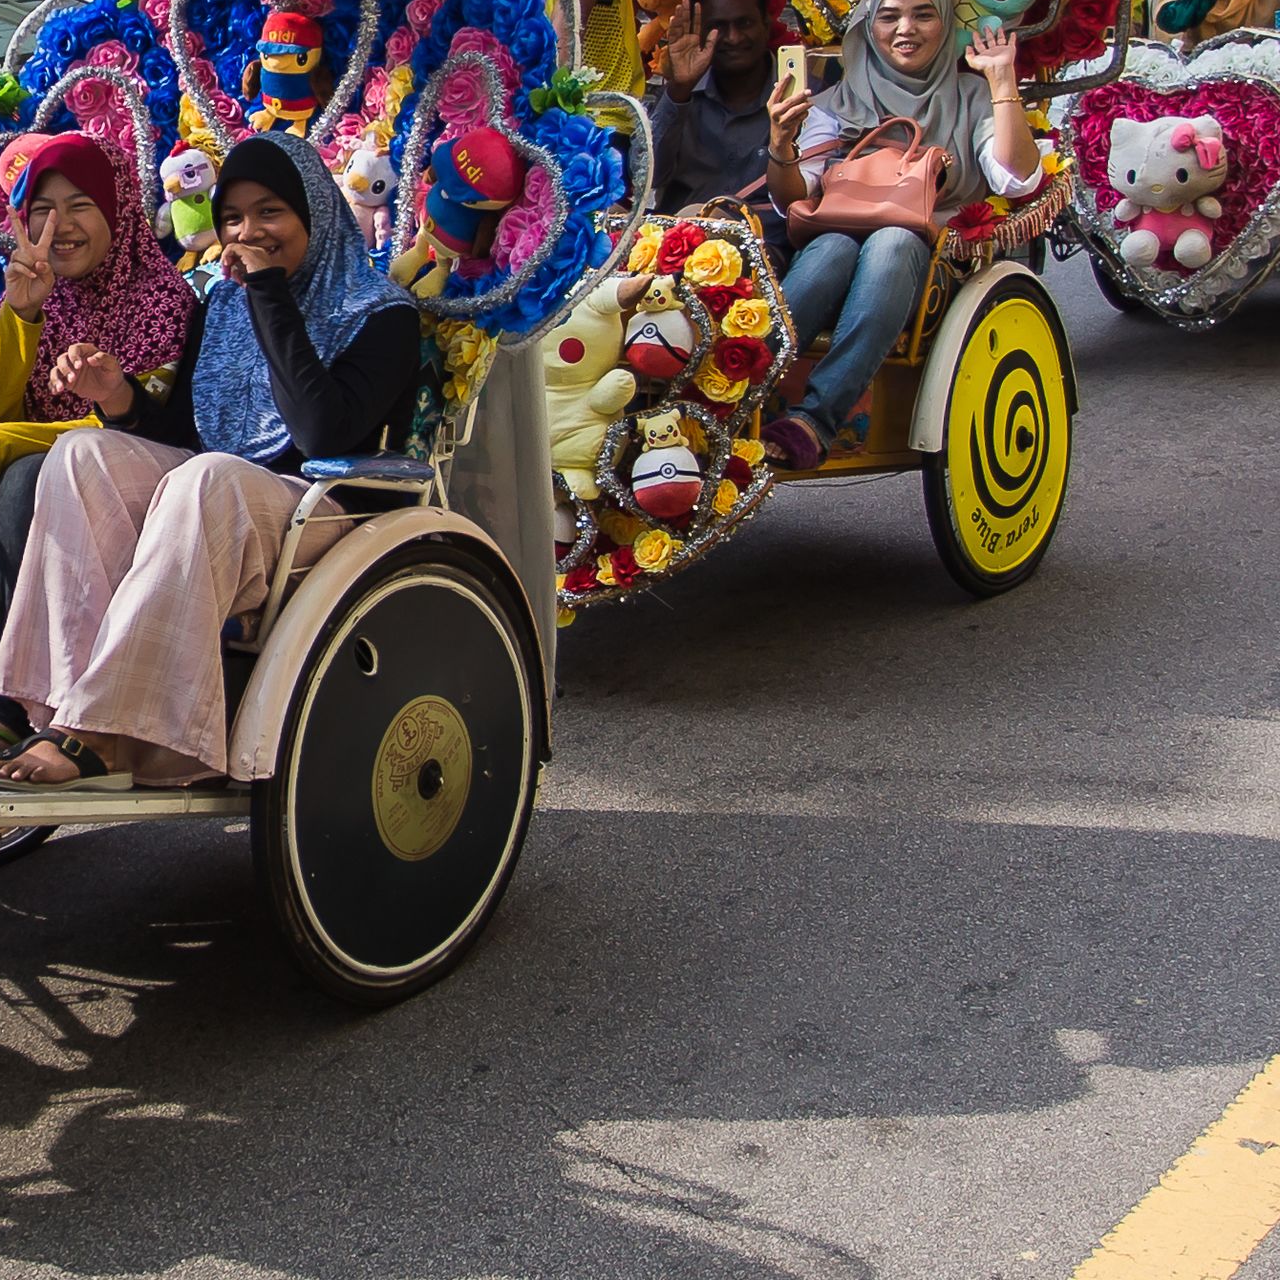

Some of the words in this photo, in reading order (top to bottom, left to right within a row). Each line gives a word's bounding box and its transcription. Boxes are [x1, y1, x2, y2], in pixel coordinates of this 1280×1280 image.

[456, 149, 484, 184] Didi
[971, 507, 1001, 554] Blue
[1006, 504, 1040, 548] Tera
